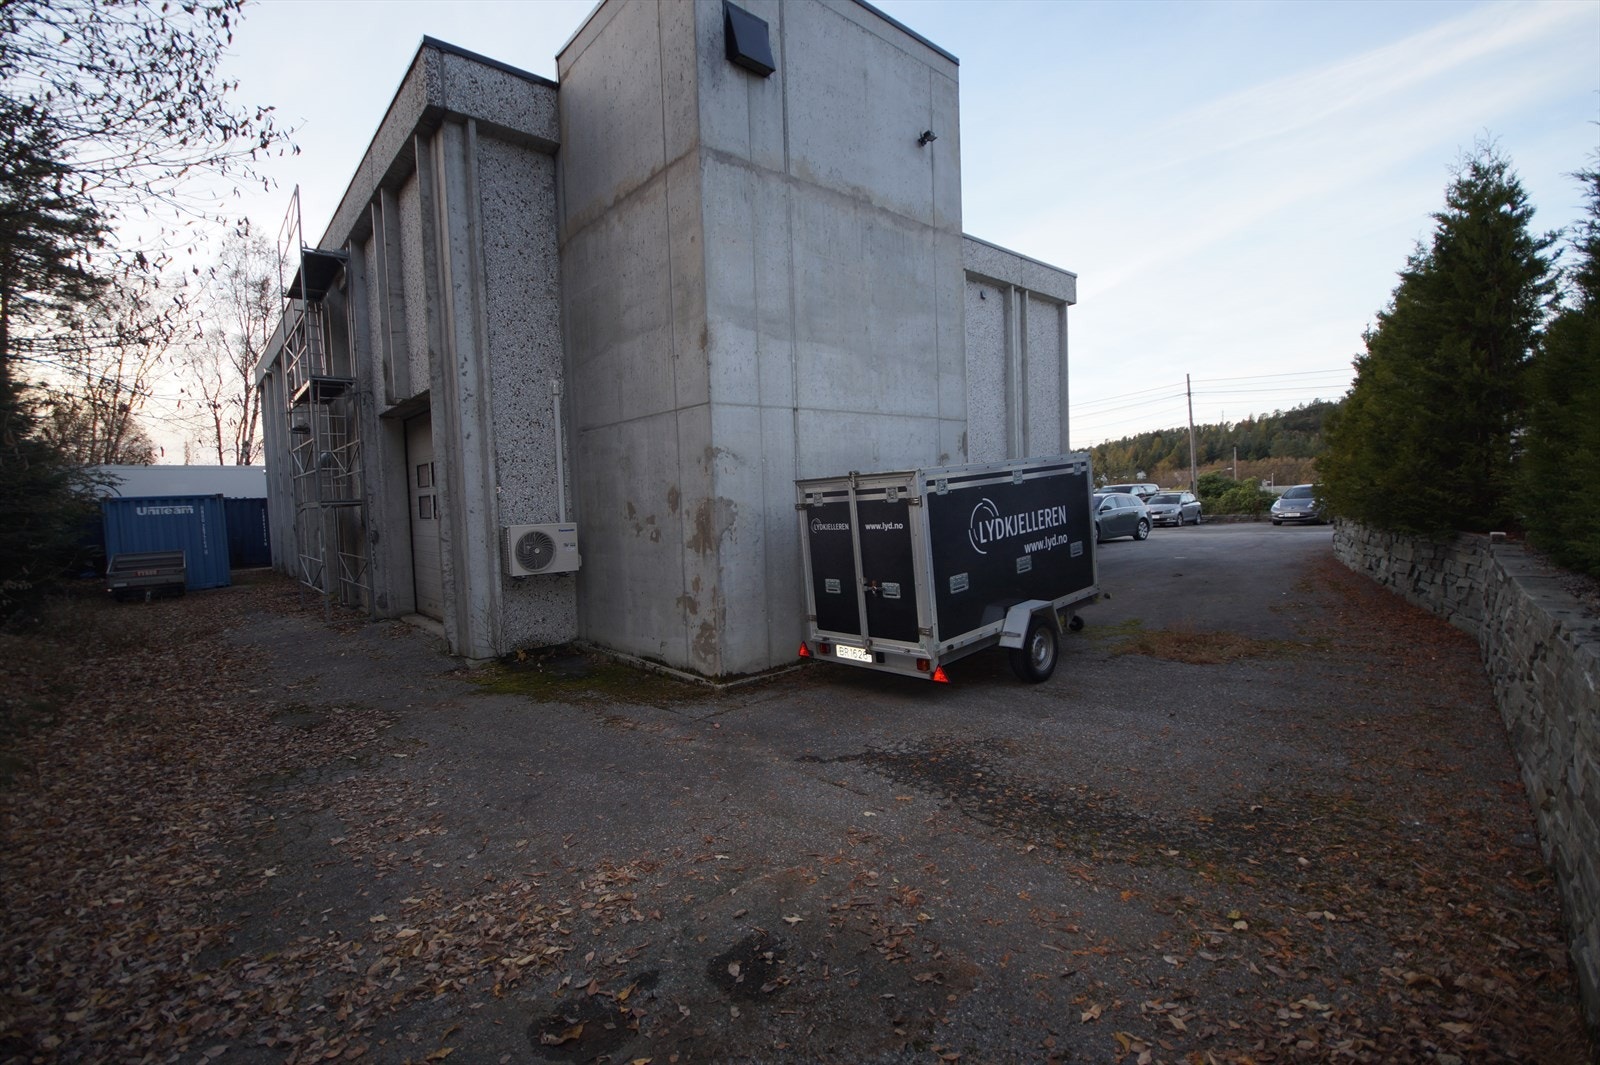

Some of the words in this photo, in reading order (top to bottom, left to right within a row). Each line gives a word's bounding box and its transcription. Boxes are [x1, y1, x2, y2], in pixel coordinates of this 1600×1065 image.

[813, 523, 850, 531] LYDKJELLEREN
[865, 522, 904, 531] www.lyd.no
[979, 505, 1067, 544] LYDKJELLEREN
[1024, 534, 1068, 553] www.lyd.no
